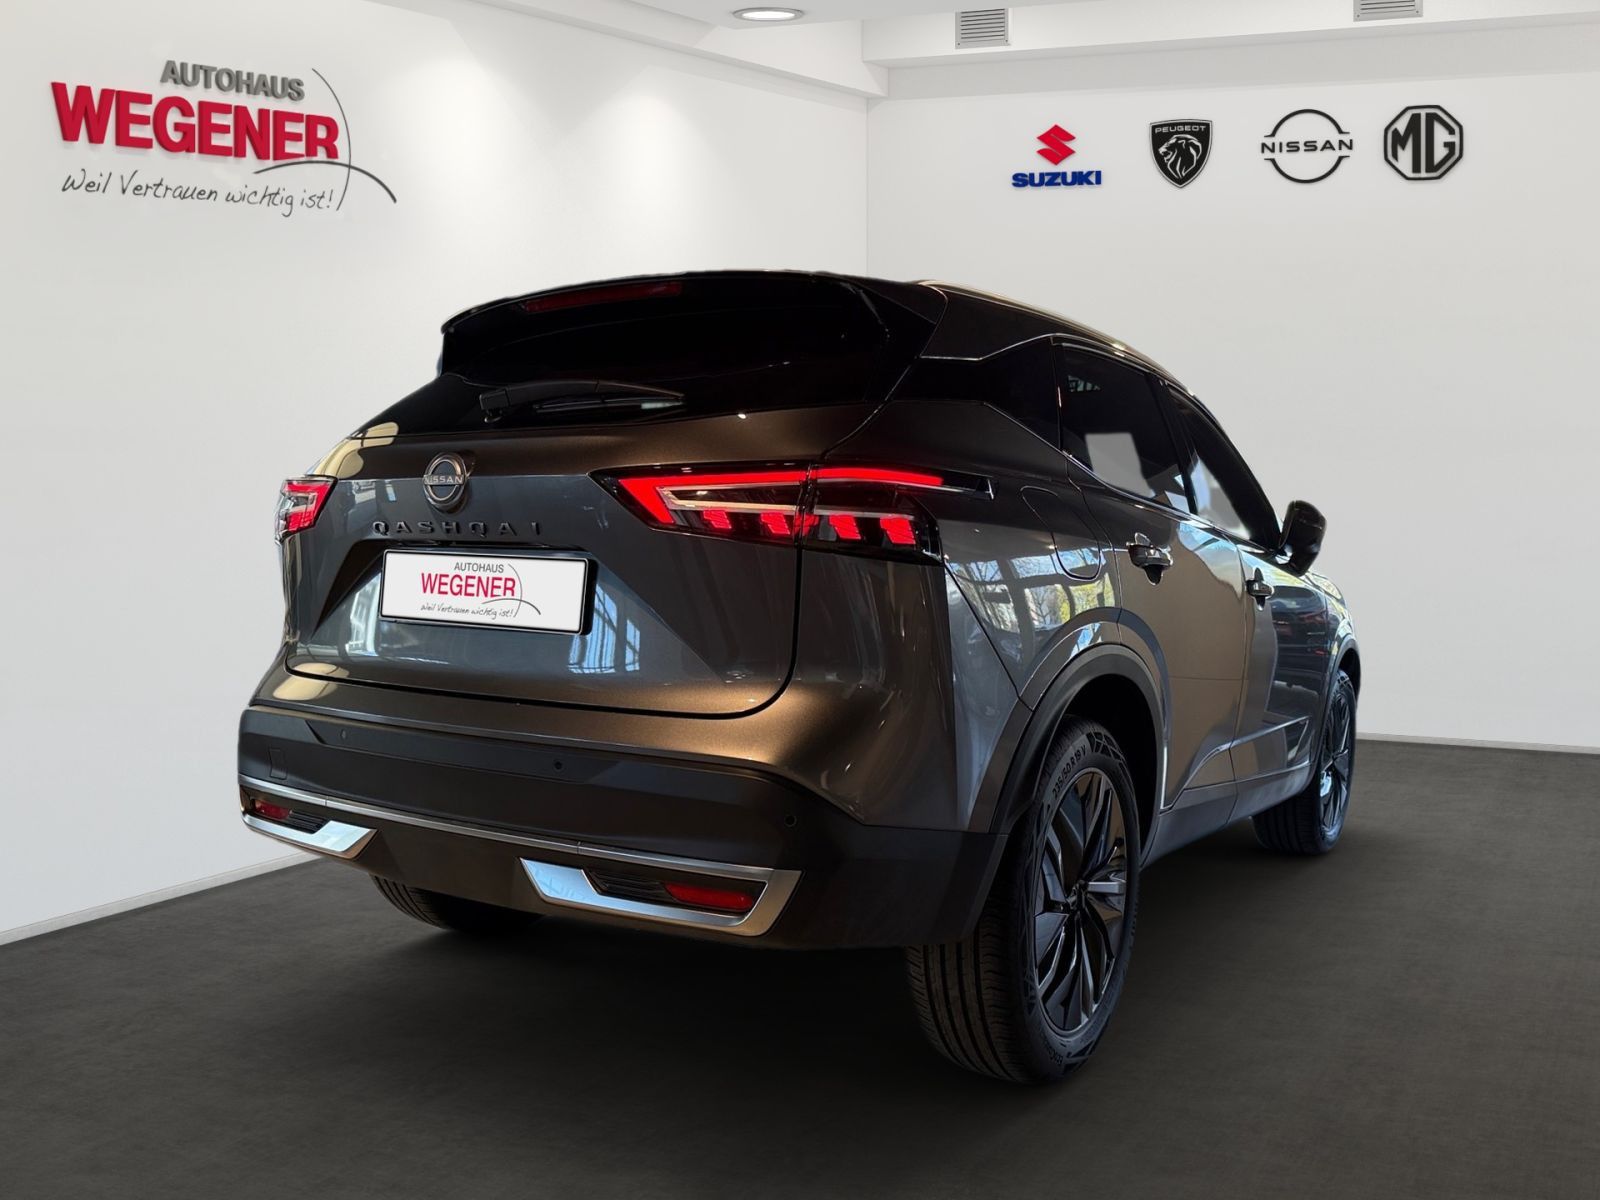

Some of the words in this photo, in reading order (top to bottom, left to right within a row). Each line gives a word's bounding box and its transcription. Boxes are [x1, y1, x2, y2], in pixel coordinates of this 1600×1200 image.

[160, 59, 305, 101] AUTOHAUS
[50, 81, 340, 161] WEGENER
[1154, 125, 1207, 134] PEUGEOT
[1261, 138, 1354, 154] NISSAN
[1391, 112, 1456, 174] MG
[1011, 170, 1103, 188] SUZUKI
[62, 168, 113, 194] Weil
[120, 169, 218, 202] Vertrauen
[225, 185, 294, 217] wichtig
[300, 189, 333, 210] ist!
[424, 474, 464, 484] NISSAN
[372, 521, 543, 537] QASHQAI
[453, 562, 505, 574] AUTOHAUS
[421, 573, 516, 598] WEGENER
[437, 602, 470, 614] Vertrauen
[471, 607, 497, 620] wichtig
